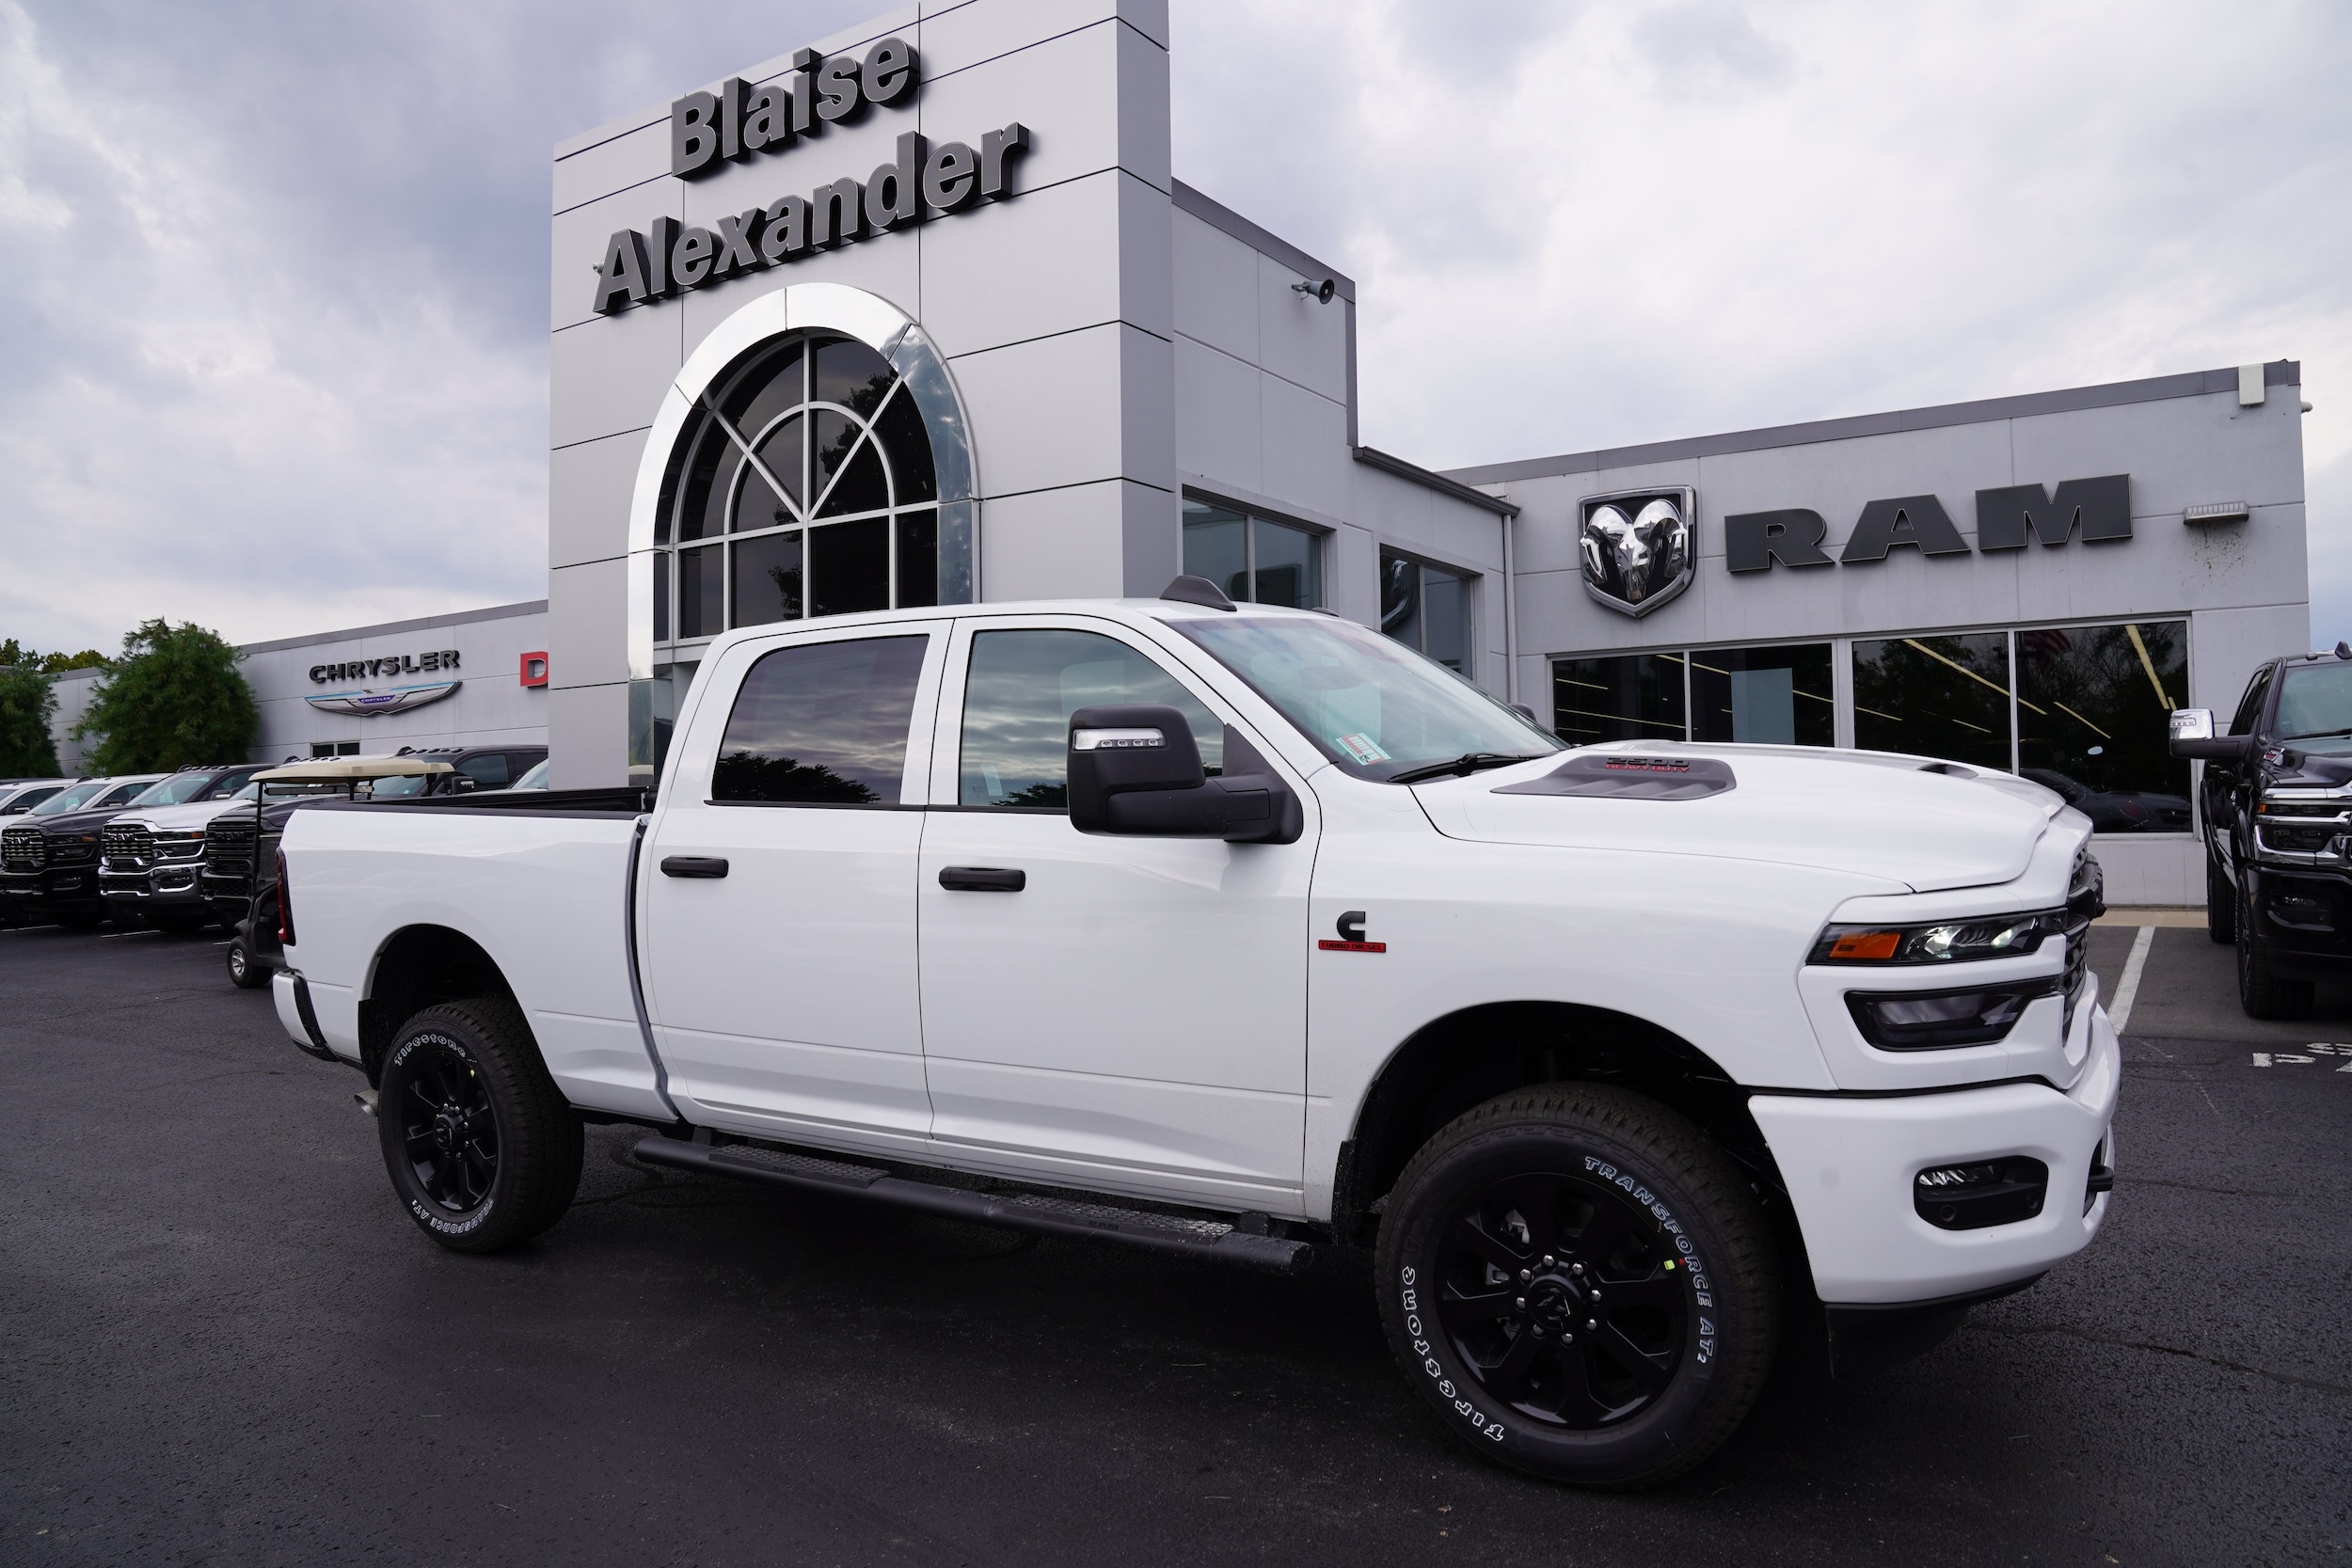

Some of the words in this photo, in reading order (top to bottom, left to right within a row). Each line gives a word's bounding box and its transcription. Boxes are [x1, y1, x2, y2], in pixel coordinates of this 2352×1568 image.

[671, 36, 921, 181] Blaise
[592, 121, 1030, 316] Alexander
[1724, 473, 2134, 574] RAM
[309, 649, 460, 684] CHRYSLER
[1606, 757, 1691, 768] 2500
[1651, 765, 1691, 773] DUTY
[1584, 1156, 1713, 1308] TRANSFORCE
